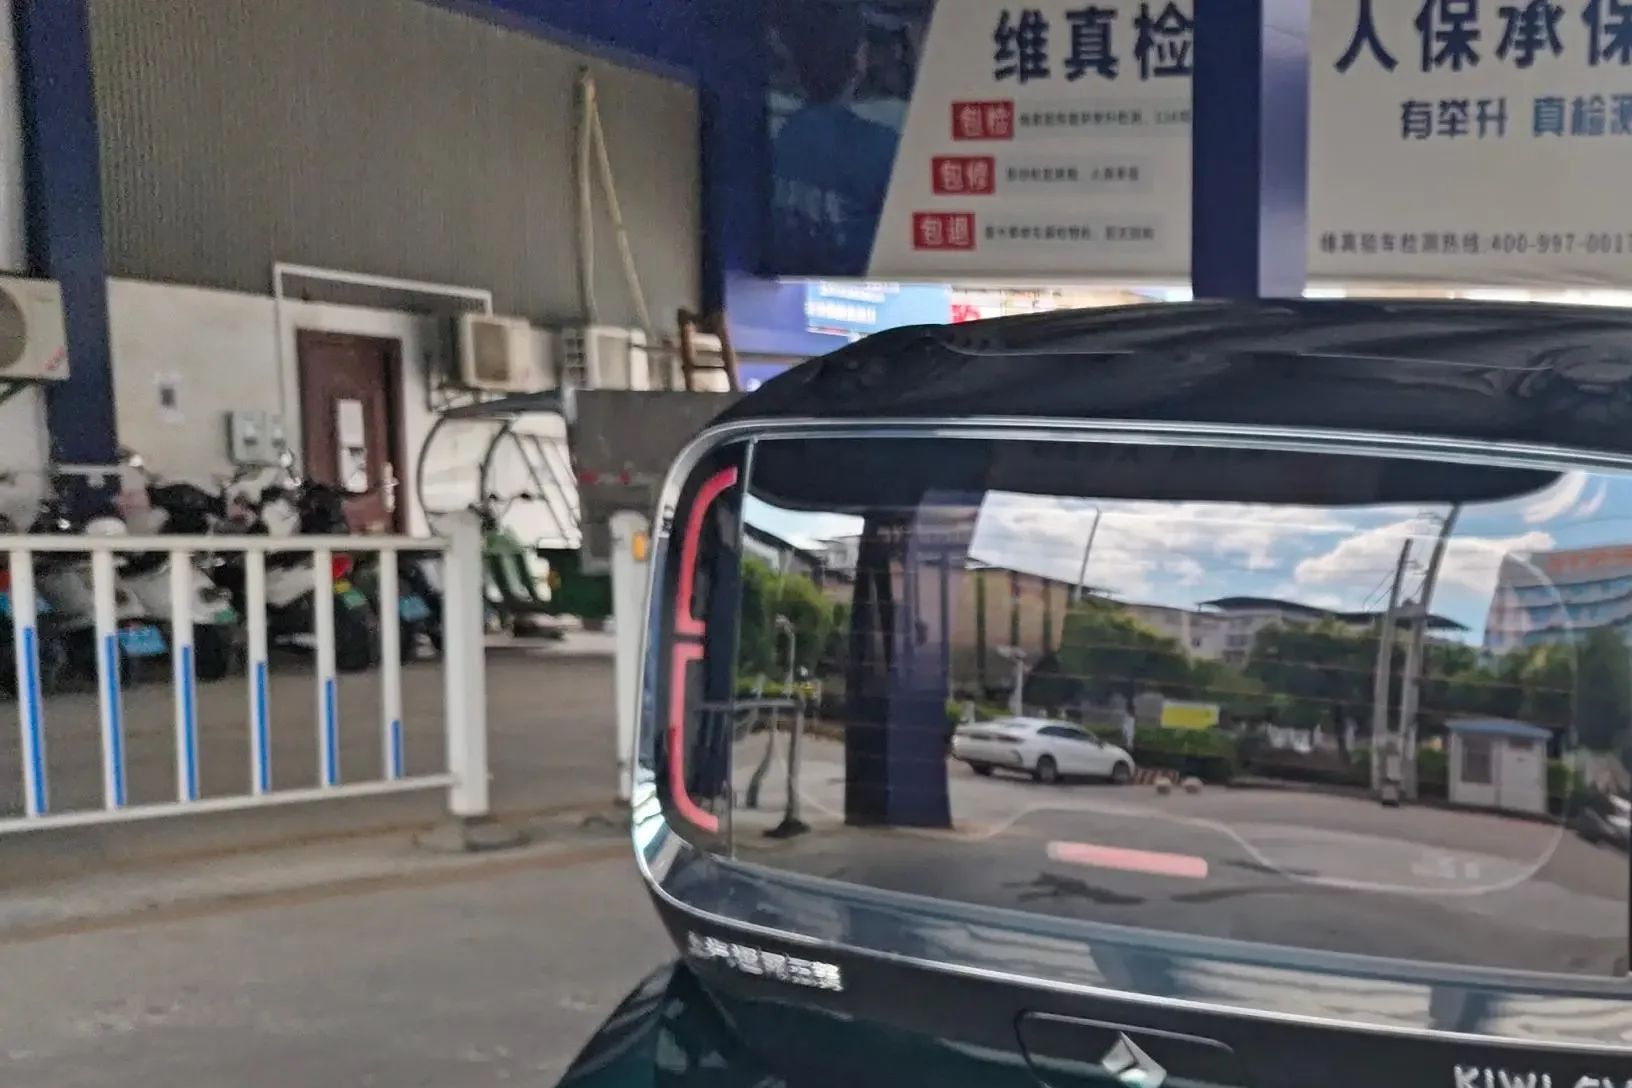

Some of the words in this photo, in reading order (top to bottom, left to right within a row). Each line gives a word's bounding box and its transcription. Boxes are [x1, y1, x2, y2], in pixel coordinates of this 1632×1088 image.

[993, 4, 1193, 83] 维真检
[1399, 96, 1509, 141] 有举升
